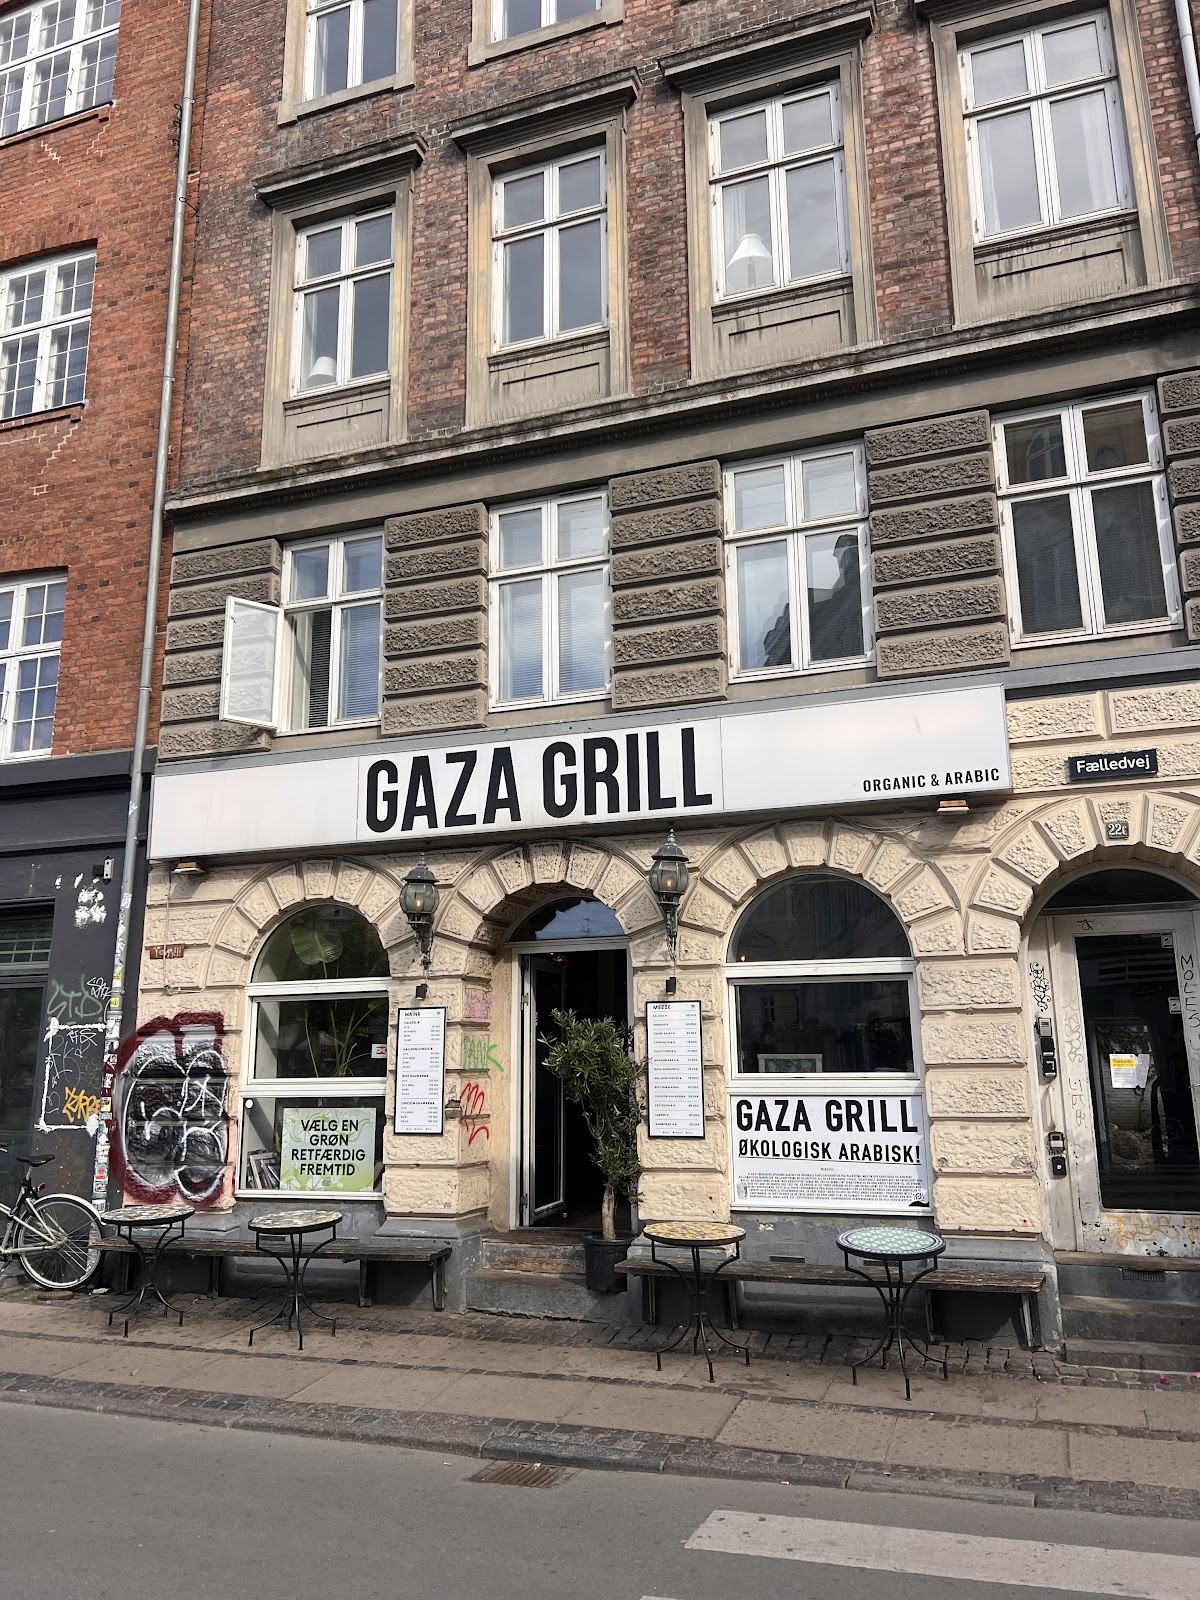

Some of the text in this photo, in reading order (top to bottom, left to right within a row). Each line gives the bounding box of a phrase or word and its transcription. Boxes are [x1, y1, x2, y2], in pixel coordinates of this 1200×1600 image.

[1076, 754, 1151, 773] Fælledvej
[366, 727, 713, 833] GAZA GRILL
[863, 768, 1000, 792] ORGANIC & ARABIC
[300, 1119, 359, 1132] VÆLG EN
[736, 1099, 919, 1133] GAZA GRILL
[309, 1134, 349, 1146] GRØN
[291, 1148, 366, 1161] RETFÆRDIG
[738, 1138, 921, 1164] ØKOLOGISK ARABISK!
[299, 1163, 356, 1176] FREMTID
